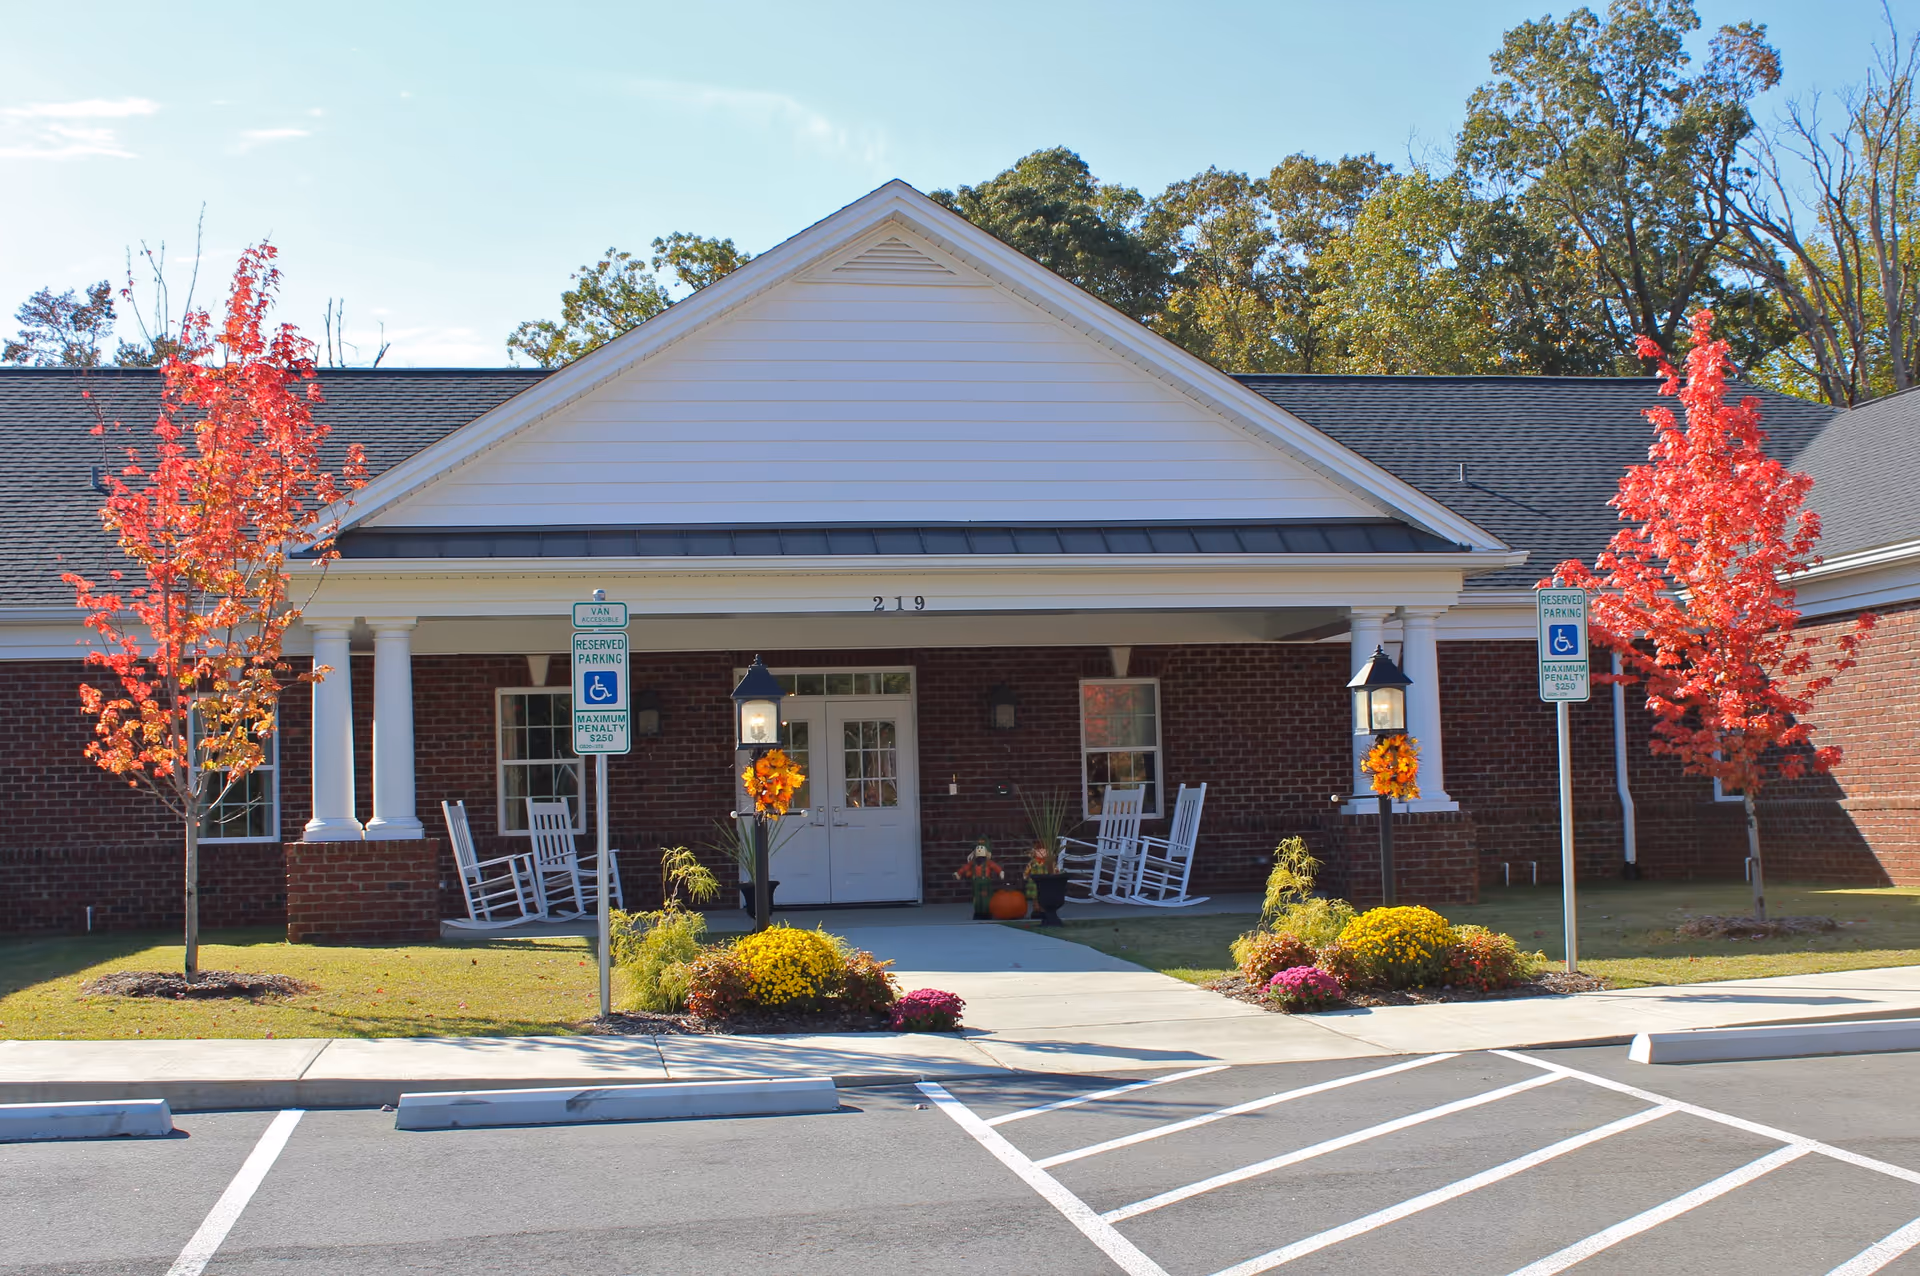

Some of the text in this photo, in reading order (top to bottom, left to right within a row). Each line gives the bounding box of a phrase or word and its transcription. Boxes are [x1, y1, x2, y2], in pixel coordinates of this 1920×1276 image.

[873, 596, 925, 610] 219
[1541, 595, 1582, 604] RESERVED
[1544, 608, 1581, 618] PARKING
[576, 640, 624, 650] RESERVED
[578, 654, 622, 664] PARKING
[1544, 664, 1586, 672] MAXIMUM
[1544, 674, 1585, 682] PENALTY
[1555, 682, 1576, 690] $250
[577, 714, 626, 723] MAXIMUM
[578, 724, 625, 732] PENALTY
[590, 734, 614, 742] $250
